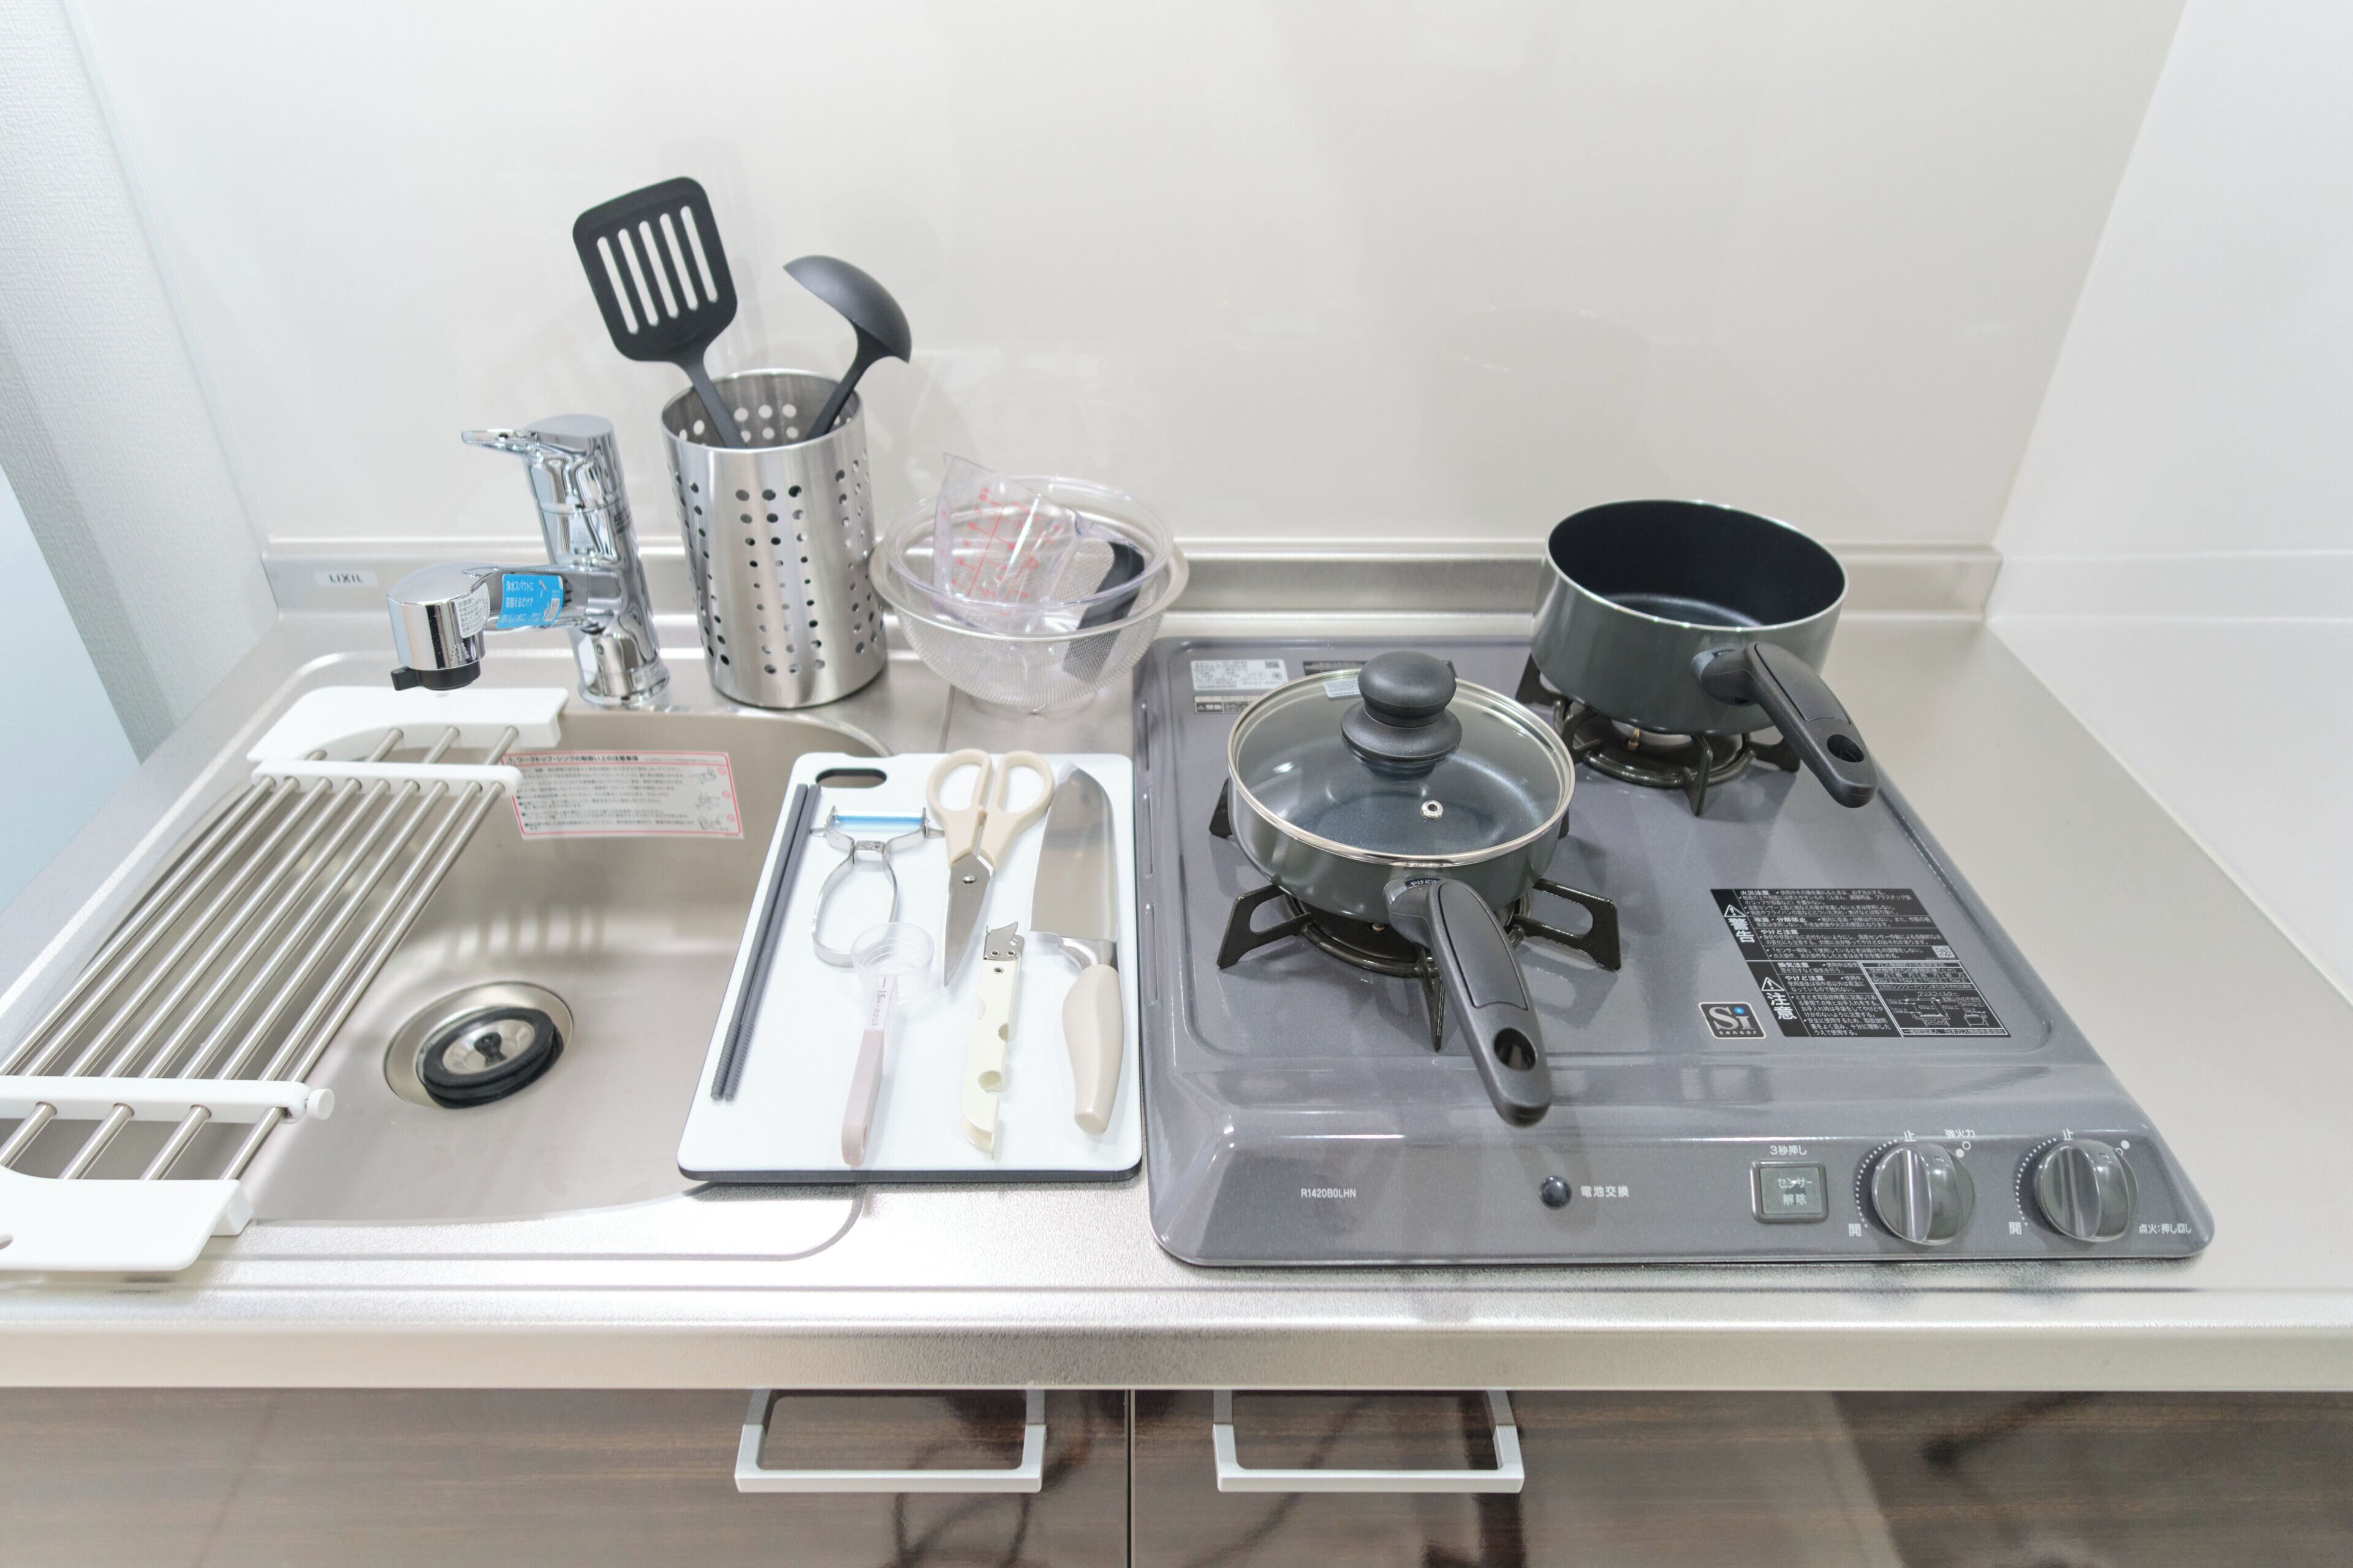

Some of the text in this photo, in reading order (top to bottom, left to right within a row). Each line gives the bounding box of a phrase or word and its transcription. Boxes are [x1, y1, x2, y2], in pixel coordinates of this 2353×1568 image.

[329, 574, 363, 583] LIXIL
[506, 580, 534, 591] 浄水スパウトに
[506, 597, 533, 608] 取替えるだけで
[1729, 917, 1755, 943] 警告
[1766, 992, 1797, 1020] 注意
[1904, 1129, 1916, 1142] 止
[1944, 1129, 1976, 1138] 強火力
[2063, 1128, 2074, 1140] 止
[1770, 1145, 1807, 1156] 3秒押し
[1778, 1176, 1813, 1188] センサー
[1580, 1186, 1629, 1197] 電池交換
[1783, 1194, 1806, 1205] 解除
[1848, 1223, 1862, 1237] 開
[2009, 1221, 2022, 1235] 開
